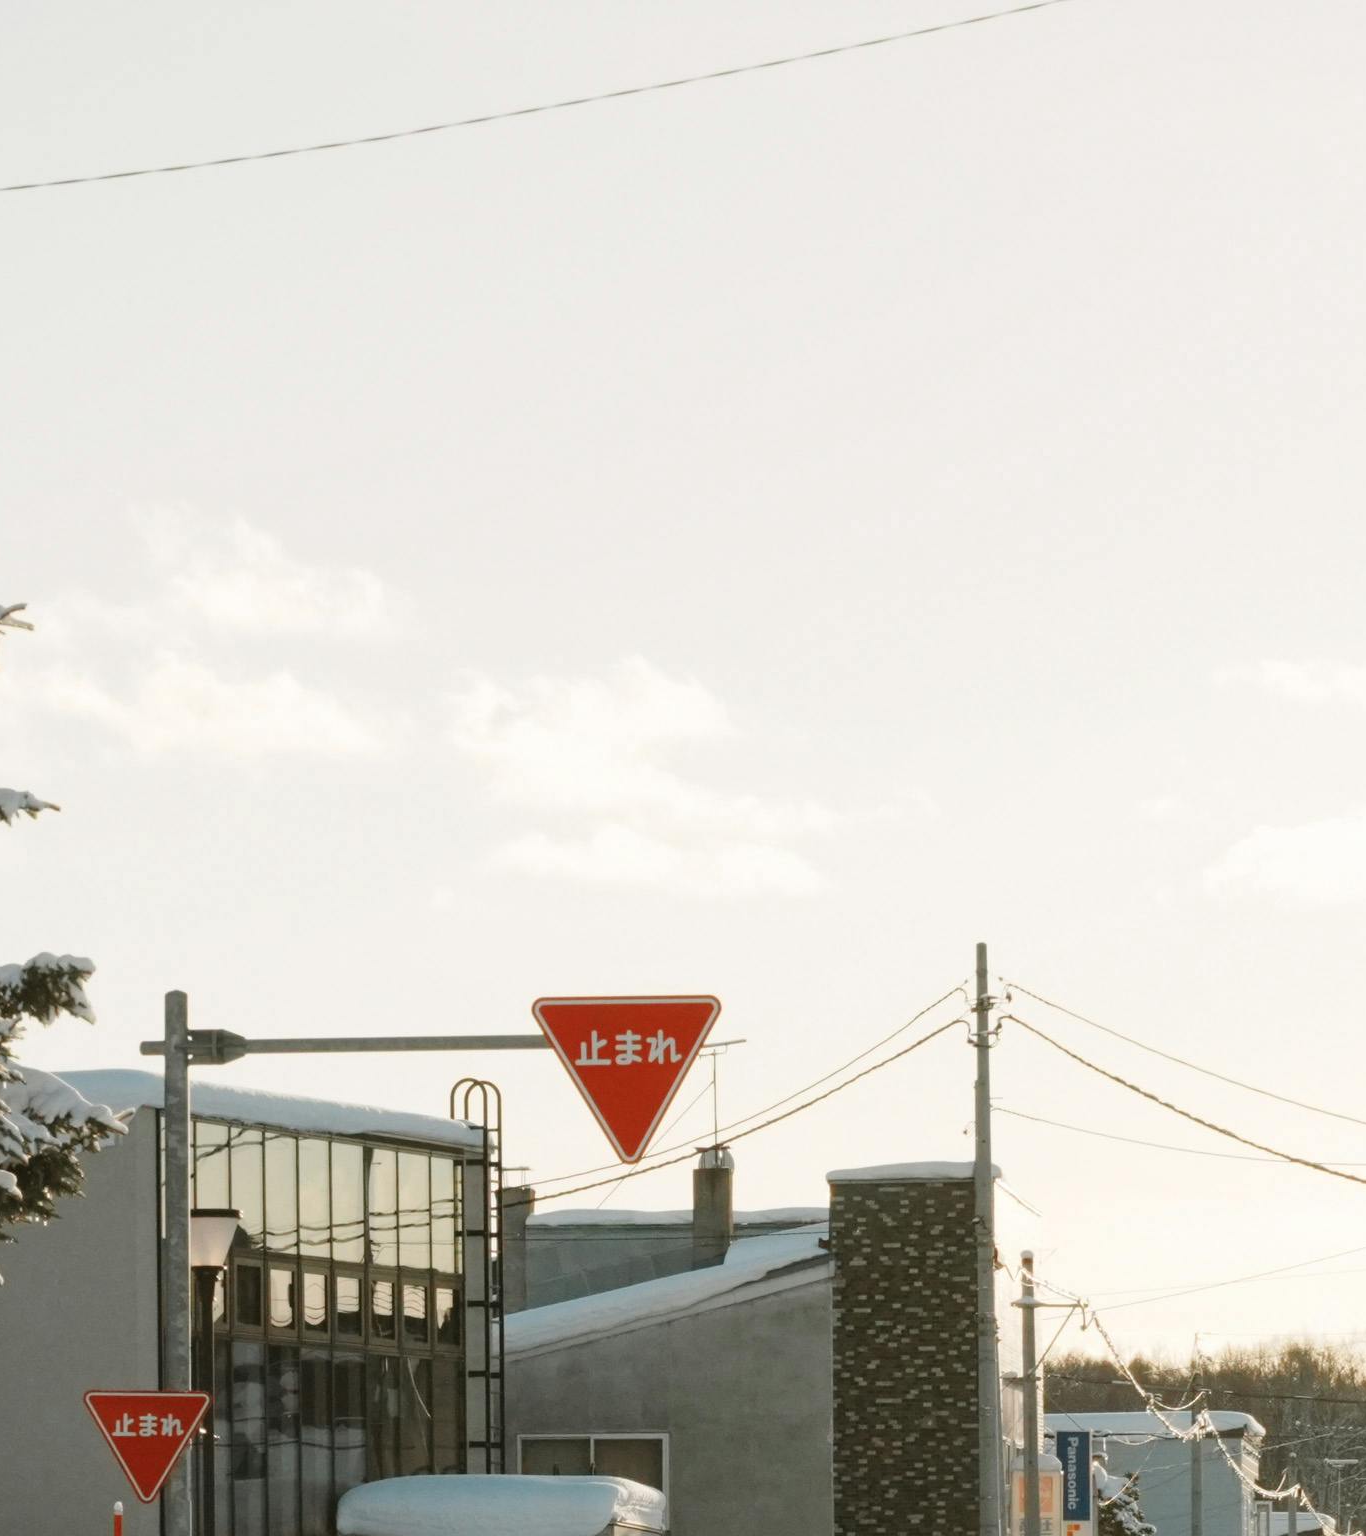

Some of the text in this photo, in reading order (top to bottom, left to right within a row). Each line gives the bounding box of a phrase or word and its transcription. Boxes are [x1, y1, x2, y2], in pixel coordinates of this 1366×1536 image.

[575, 1029, 682, 1066] 止まれ
[112, 1412, 184, 1437] 止まれ
[1067, 1436, 1080, 1511] Panasonic
